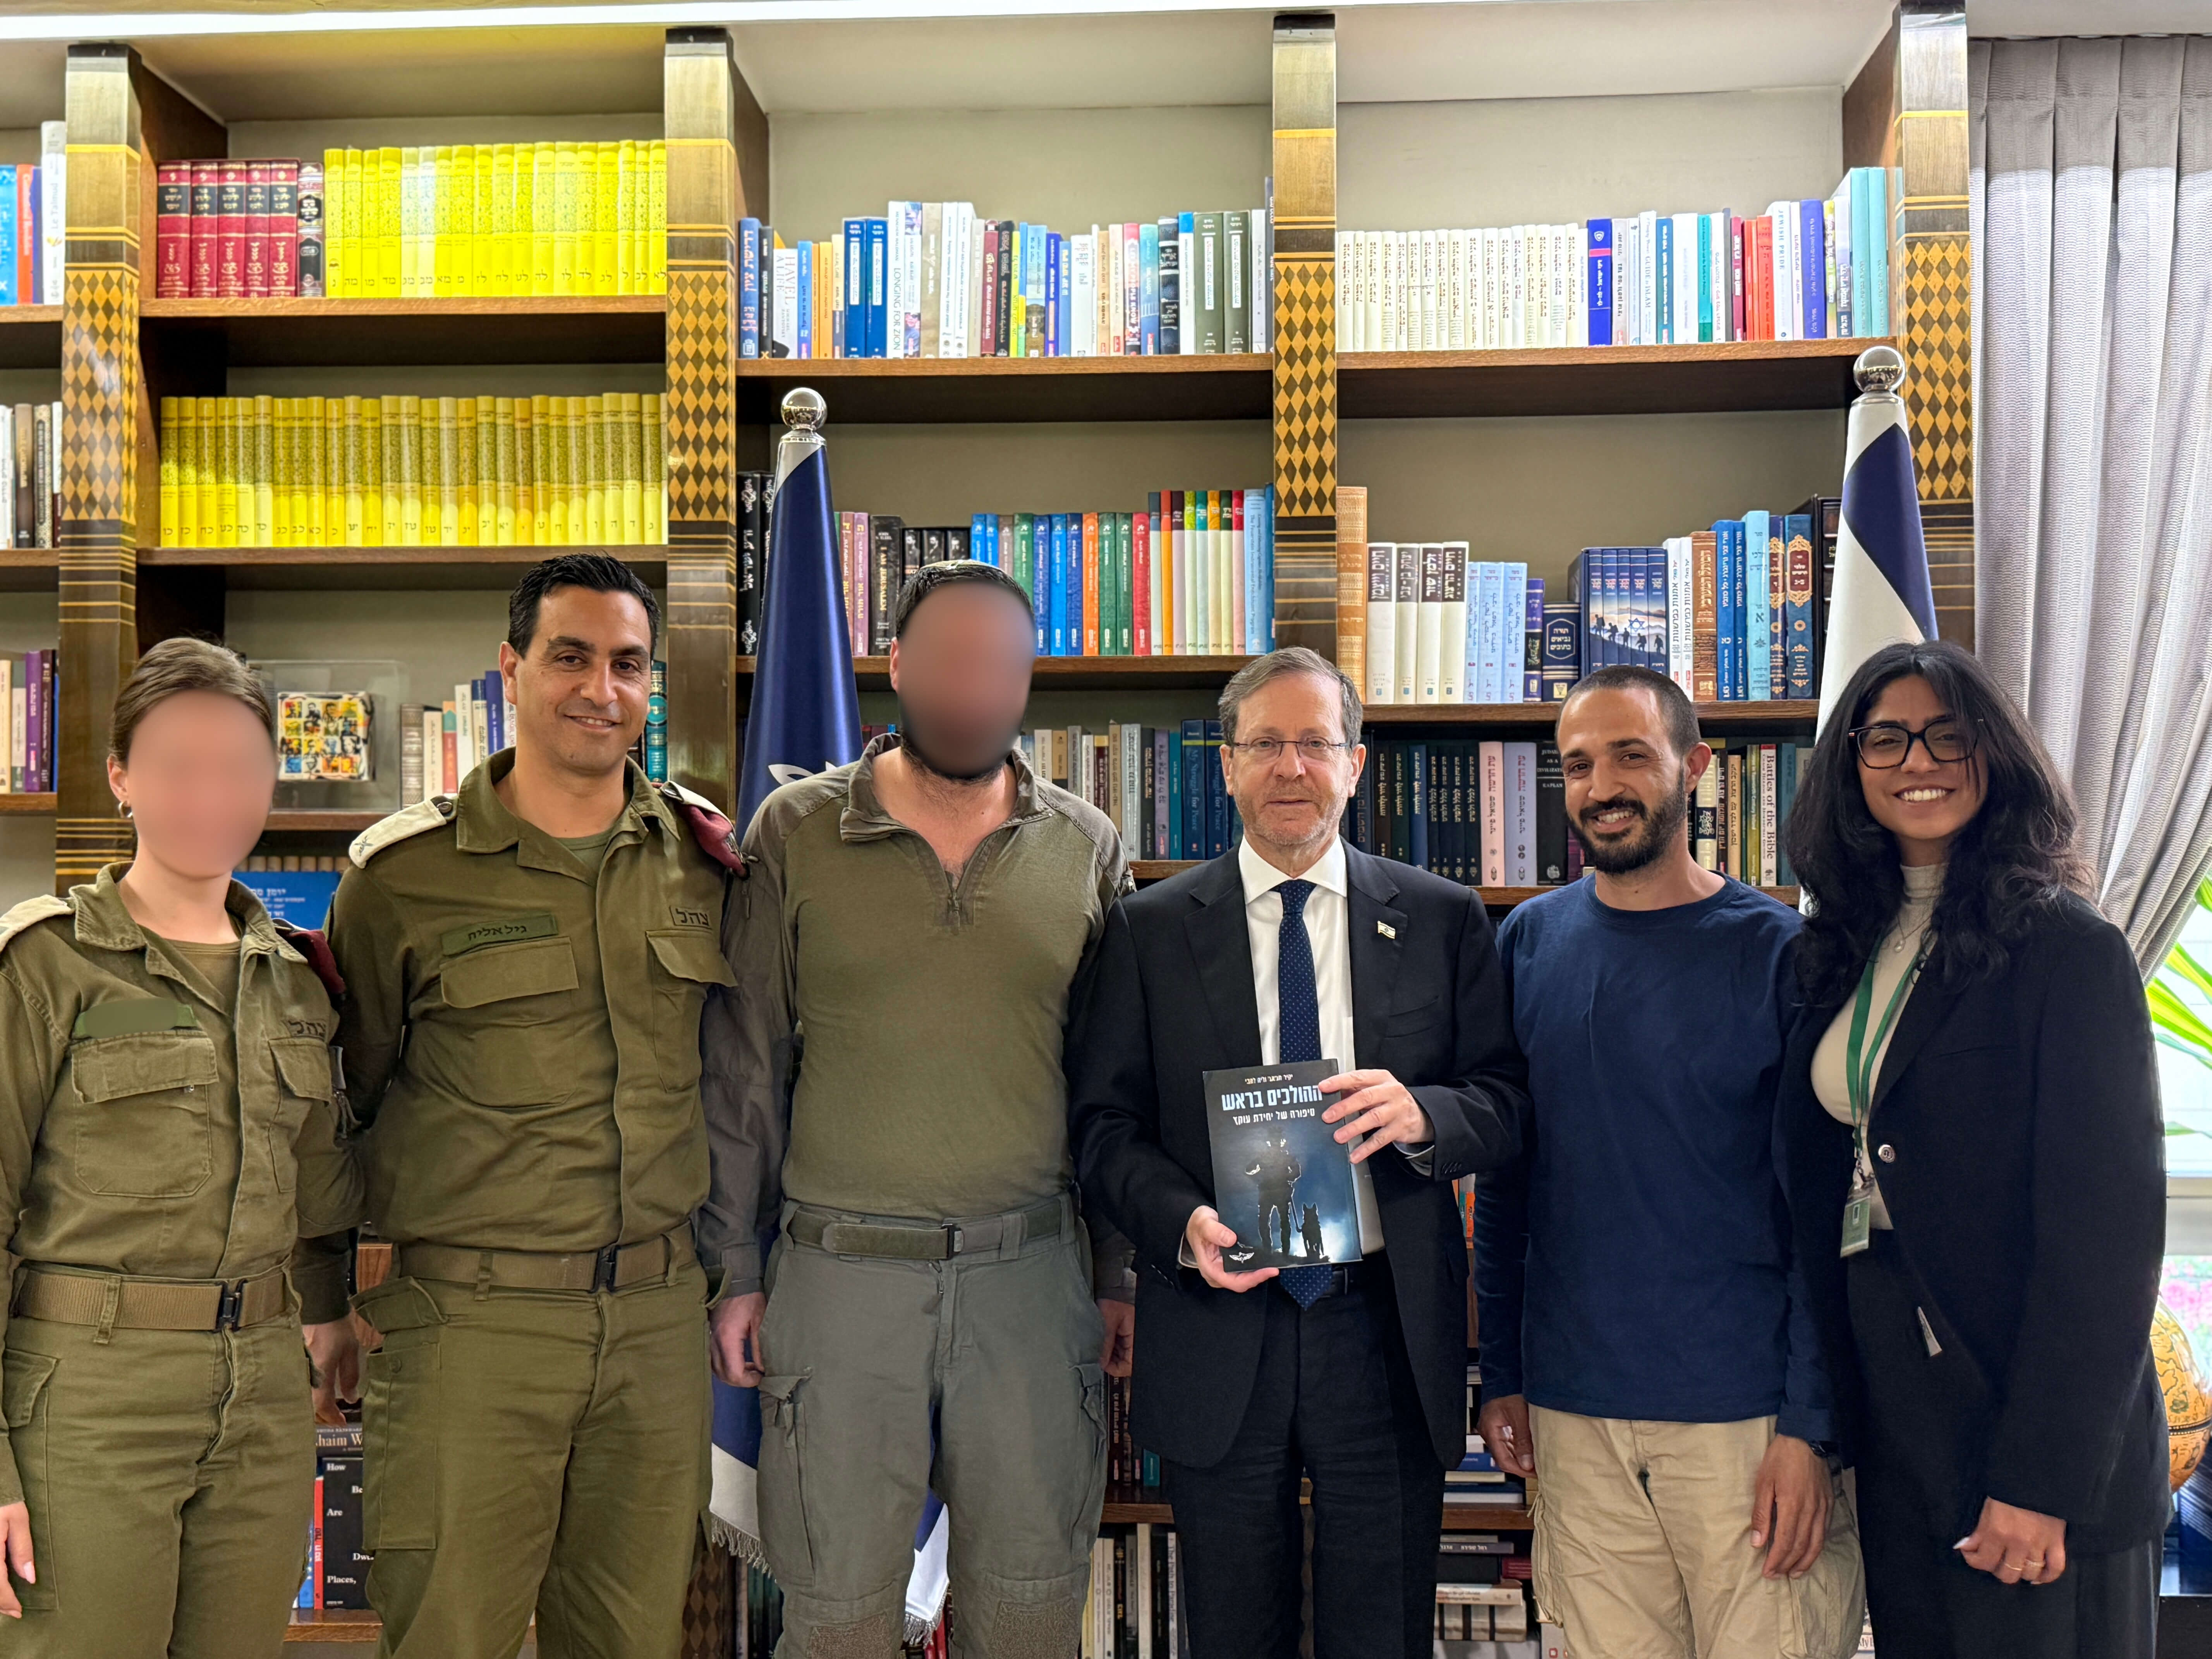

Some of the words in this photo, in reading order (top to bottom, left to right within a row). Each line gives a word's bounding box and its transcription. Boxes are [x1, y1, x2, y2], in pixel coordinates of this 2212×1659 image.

[744, 230, 755, 269] דרישת
[744, 271, 757, 292] ציון
[785, 257, 795, 305] HAVEL
[880, 553, 886, 564] AM
[1372, 551, 1385, 570] חיים
[1401, 551, 1415, 569] יצחק
[1423, 554, 1439, 575] זלמן
[1445, 552, 1455, 570] חיים
[1698, 550, 1711, 576] הכותל
[740, 553, 754, 591] ישראל
[1426, 577, 1436, 596] שזר
[1445, 574, 1454, 598] הרצוג
[1700, 577, 1712, 607] המערבי
[1756, 613, 1764, 623] א
[1191, 750, 1198, 763] My
[1488, 756, 1495, 766] עת
[1191, 764, 1199, 794] Struggle
[1767, 756, 1775, 791] Battles
[1357, 800, 1367, 809] מן
[1731, 802, 1736, 810] עם
[1767, 795, 1776, 805] of
[1767, 811, 1776, 826] the
[1767, 832, 1776, 859] Bible
[505, 926, 527, 934] גיל
[1222, 1091, 1264, 1111] בראש
[1267, 1085, 1323, 1106] ההולכים
[1233, 1115, 1250, 1125] עוקץ
[1254, 1113, 1273, 1122] יחידת
[1276, 1111, 1287, 1120] של
[1290, 1108, 1315, 1118] סיפורה
[316, 1434, 347, 1446] haim
[327, 1576, 356, 1584] Places,
